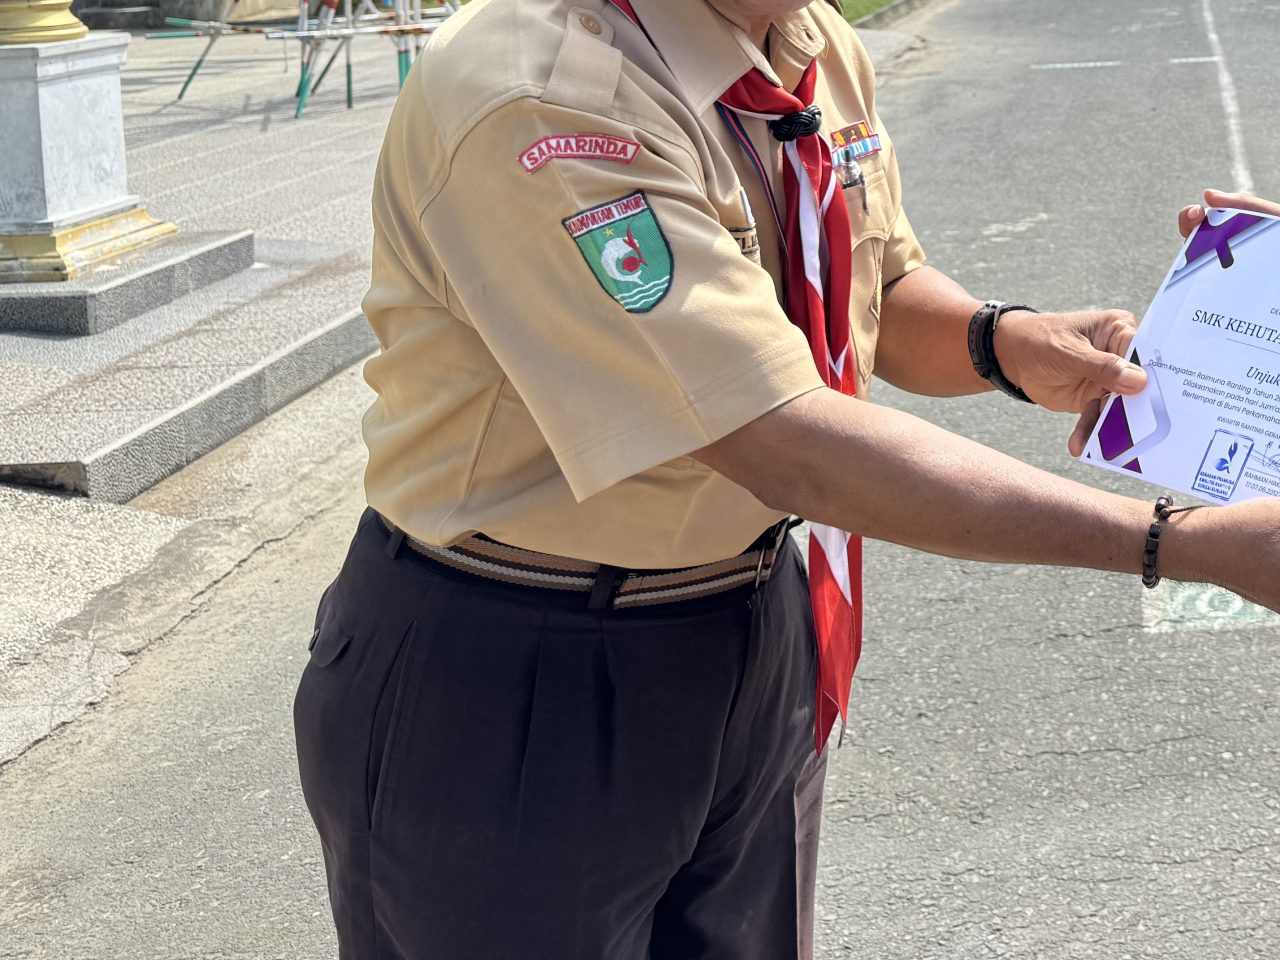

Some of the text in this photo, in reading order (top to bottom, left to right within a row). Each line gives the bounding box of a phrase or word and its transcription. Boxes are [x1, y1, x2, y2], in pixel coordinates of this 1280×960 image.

[526, 139, 629, 166] SAMARINDA
[1192, 310, 1225, 328] SMK
[1148, 359, 1168, 369] Dalam
[1168, 364, 1196, 378] Kegiatan
[1197, 372, 1226, 386] Raimuna
[1226, 381, 1252, 395] Ranting
[1253, 388, 1274, 400] Tahun
[1182, 390, 1217, 405] Bertempat
[1224, 402, 1242, 413] Bumi
[1183, 379, 1225, 397] Dilaksanakan
[1224, 393, 1245, 403] pada
[1244, 397, 1259, 406] hari
[1244, 471, 1271, 485] RAHMAN
